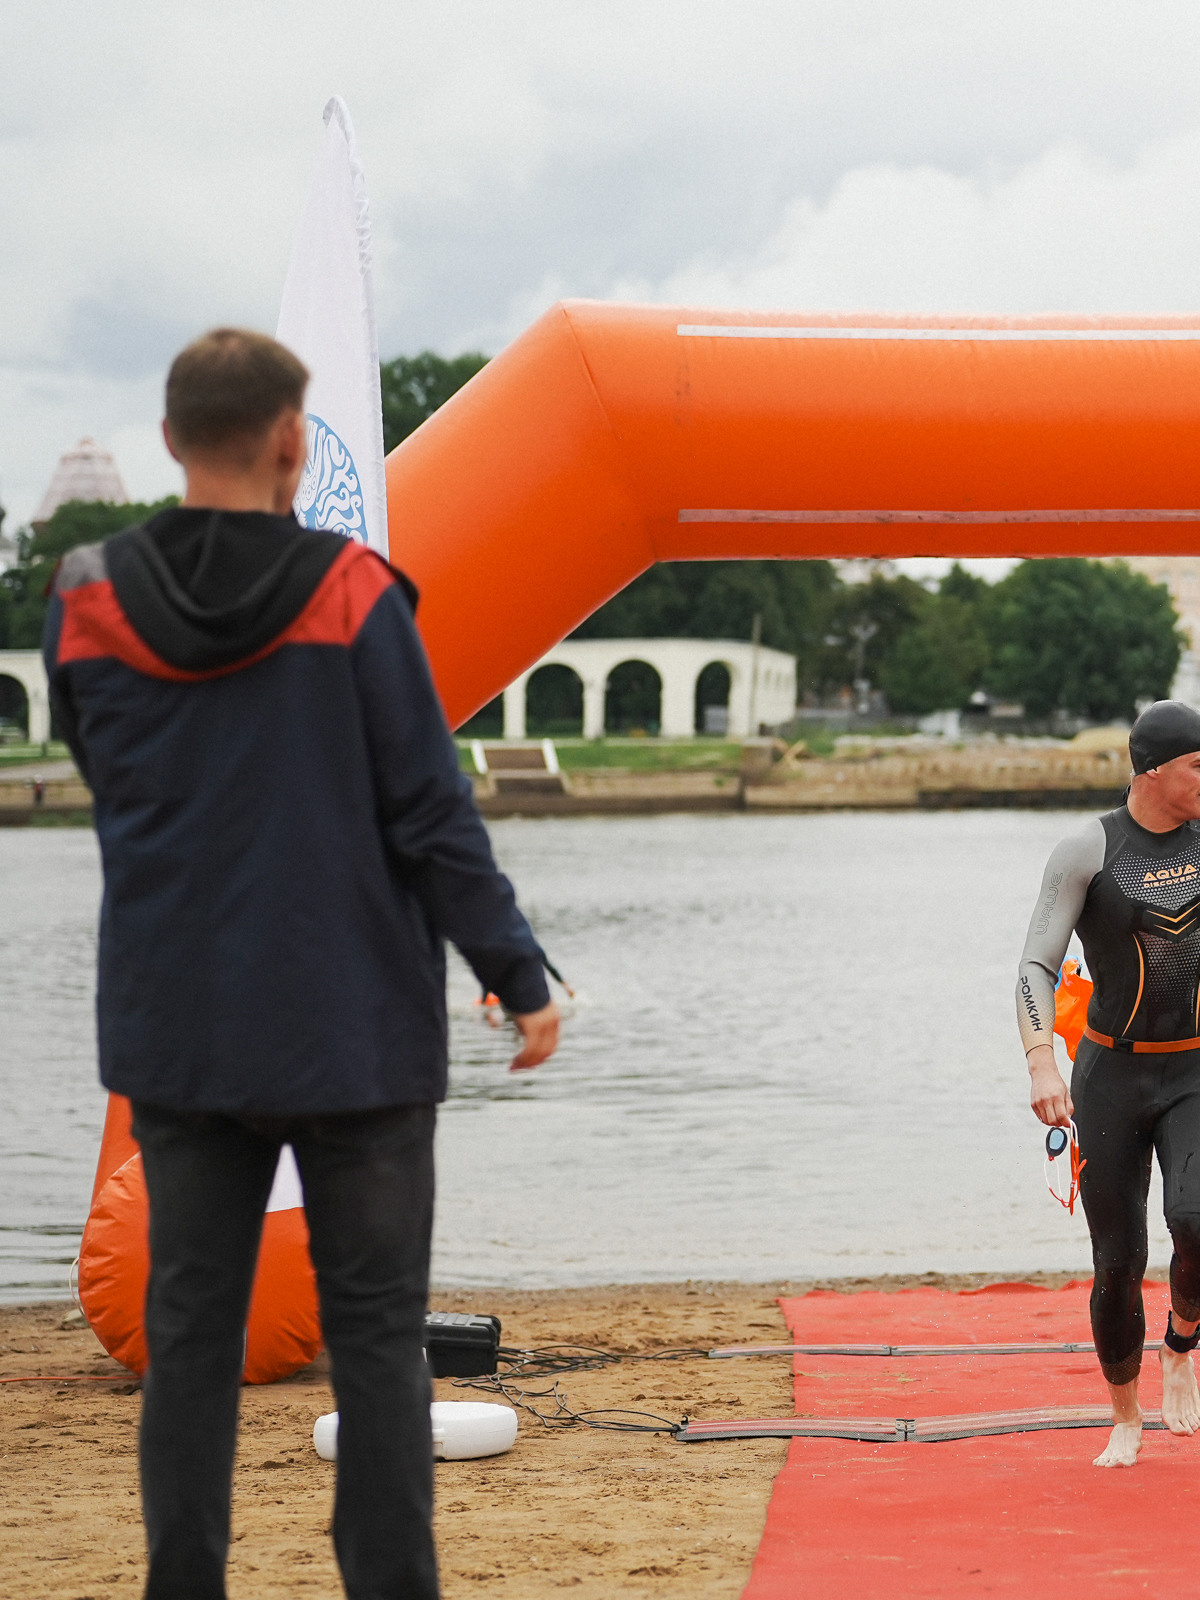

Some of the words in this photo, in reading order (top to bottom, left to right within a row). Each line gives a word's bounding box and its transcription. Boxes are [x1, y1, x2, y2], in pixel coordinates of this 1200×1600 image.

[1142, 863, 1198, 882] AQUA
[1143, 872, 1199, 889] DISCOVERY
[1020, 975, 1043, 1032] РОМКИН
